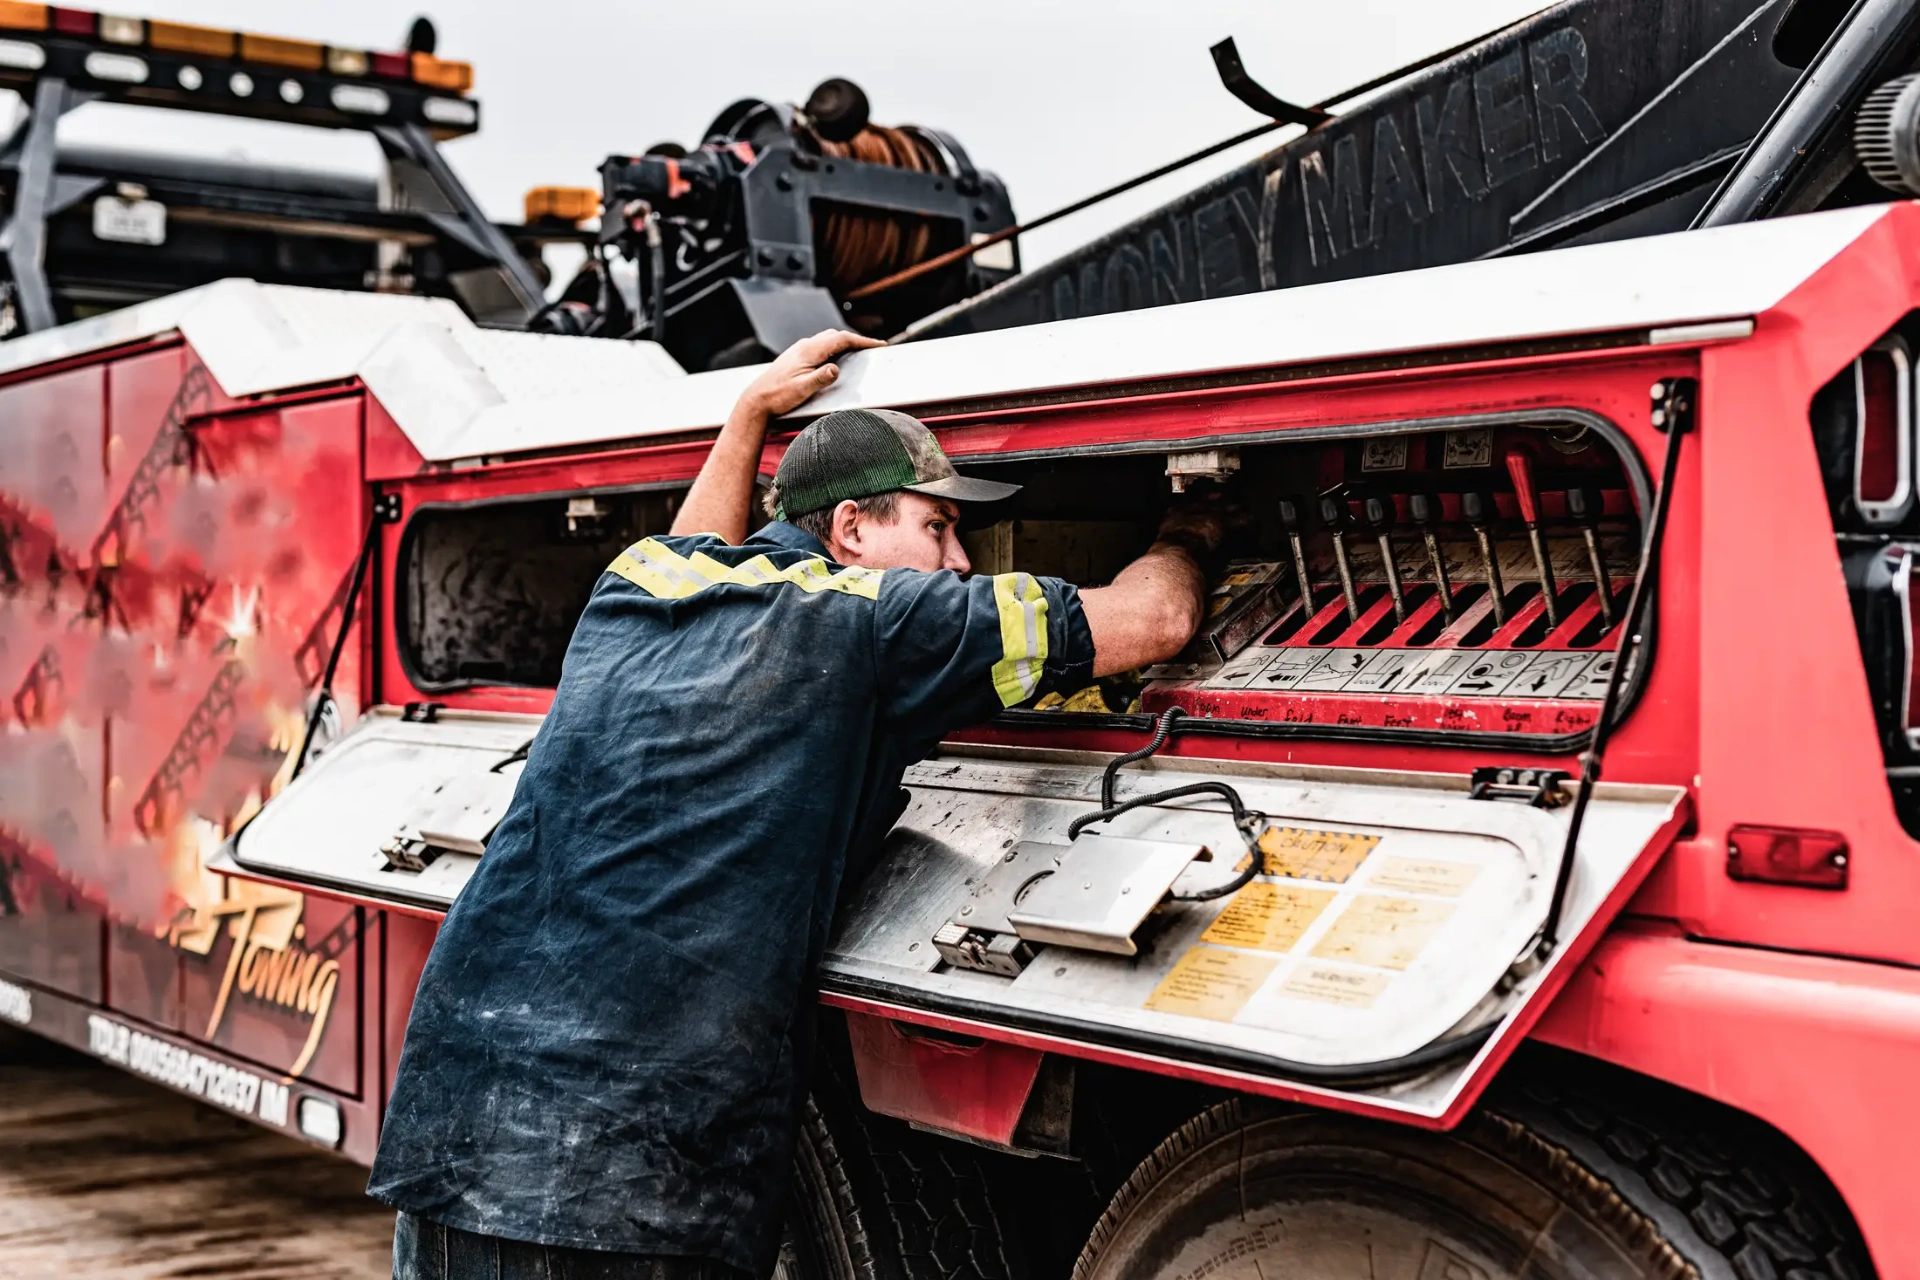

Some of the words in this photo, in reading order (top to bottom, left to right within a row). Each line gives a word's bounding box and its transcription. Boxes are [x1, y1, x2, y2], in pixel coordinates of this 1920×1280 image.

[1052, 160, 1288, 319] MONEY
[1299, 26, 1608, 268] MAKER
[1280, 837, 1349, 854] CAUTION
